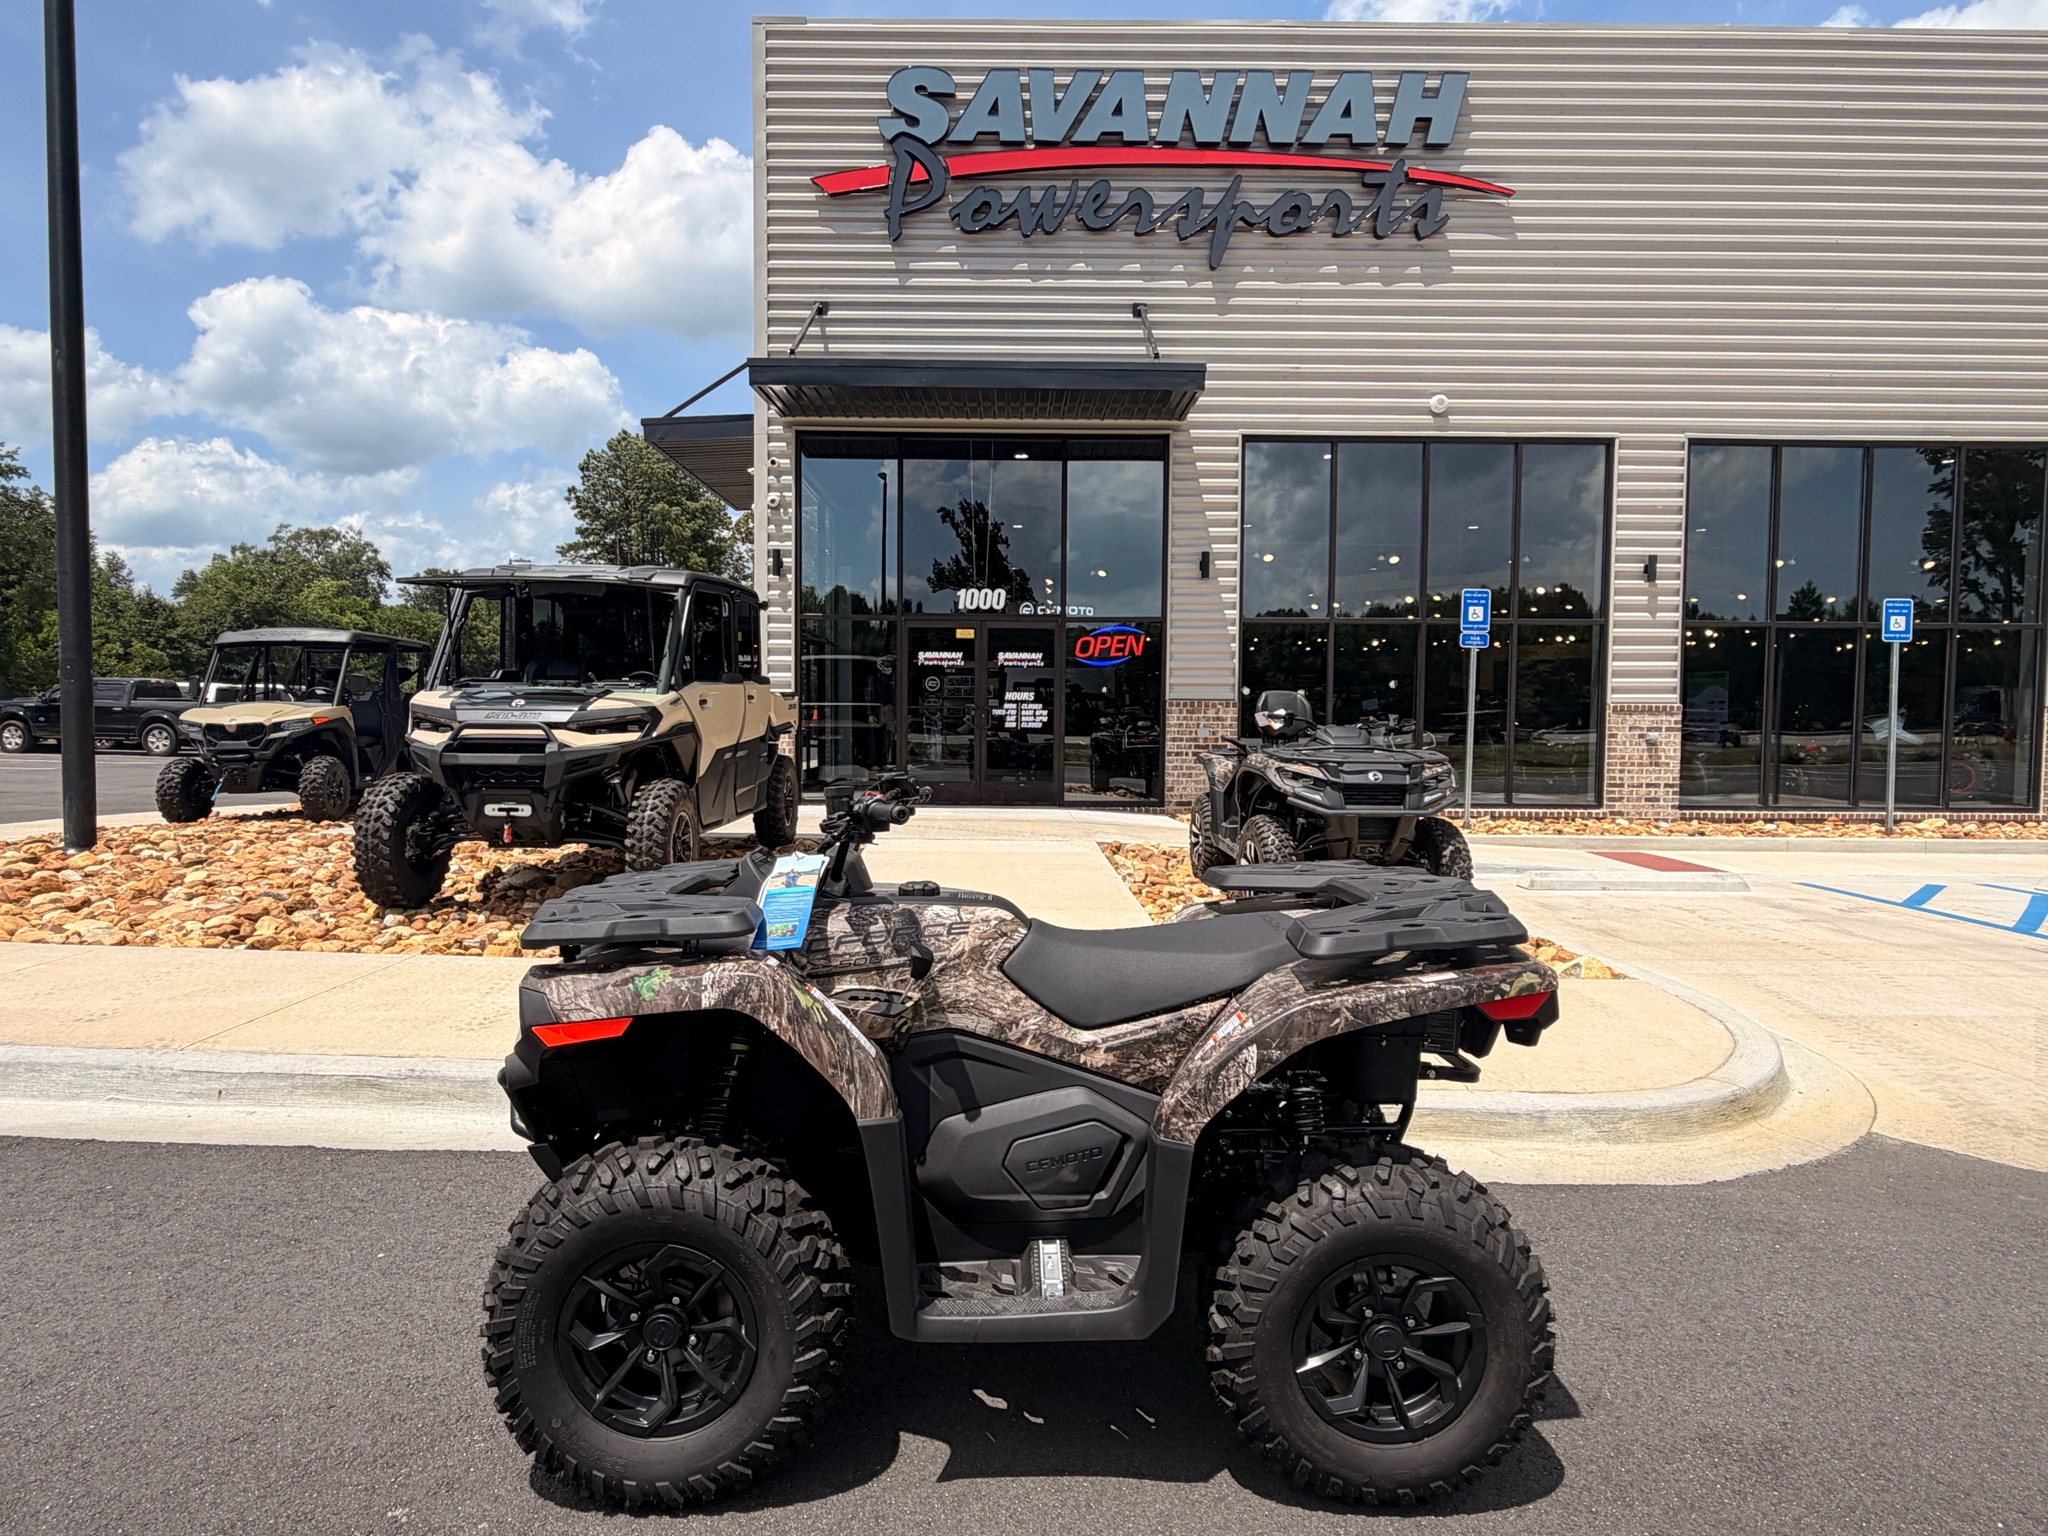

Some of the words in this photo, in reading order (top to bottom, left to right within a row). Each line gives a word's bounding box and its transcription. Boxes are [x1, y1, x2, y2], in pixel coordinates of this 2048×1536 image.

[877, 65, 1471, 148] SAVANNAH
[885, 133, 1452, 270] Powersports
[956, 588, 1006, 610] 1000
[917, 651, 964, 659] SAVANNAH
[1075, 634, 1146, 658] OPEN
[917, 657, 965, 668] Powersports
[997, 651, 1043, 660] SAVANNAH
[997, 657, 1045, 669] Powersports
[1004, 691, 1035, 701] HOURS
[806, 921, 971, 954] CFORCE
[838, 954, 884, 969] 500
[1025, 1147, 1103, 1173] CFMOTO
